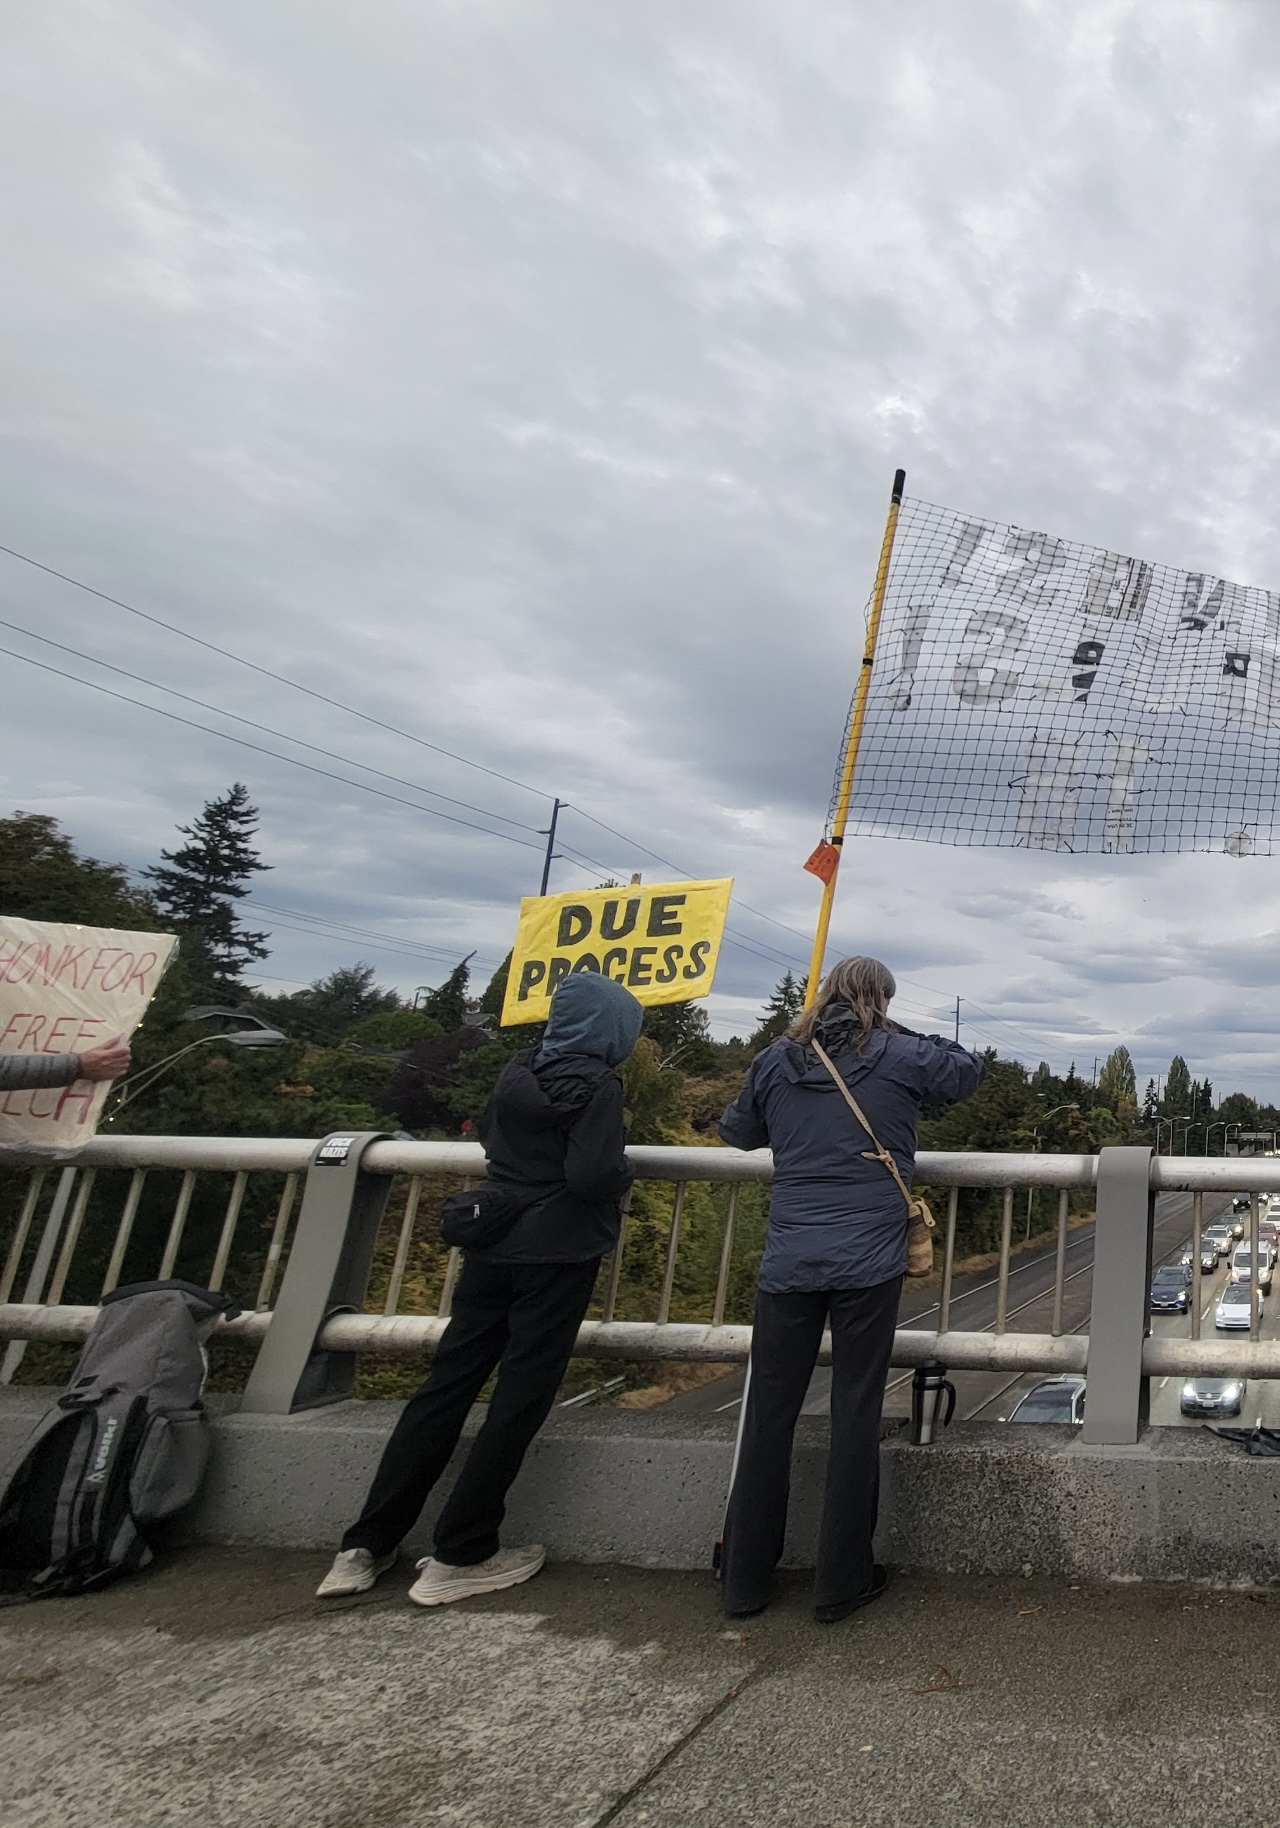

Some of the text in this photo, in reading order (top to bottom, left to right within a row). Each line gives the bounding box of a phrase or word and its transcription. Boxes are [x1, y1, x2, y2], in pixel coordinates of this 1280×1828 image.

[557, 894, 686, 947] DUE
[0, 938, 157, 995] HONK FOR
[1, 1013, 106, 1054] FREE
[319, 1146, 349, 1158] NAZIS
